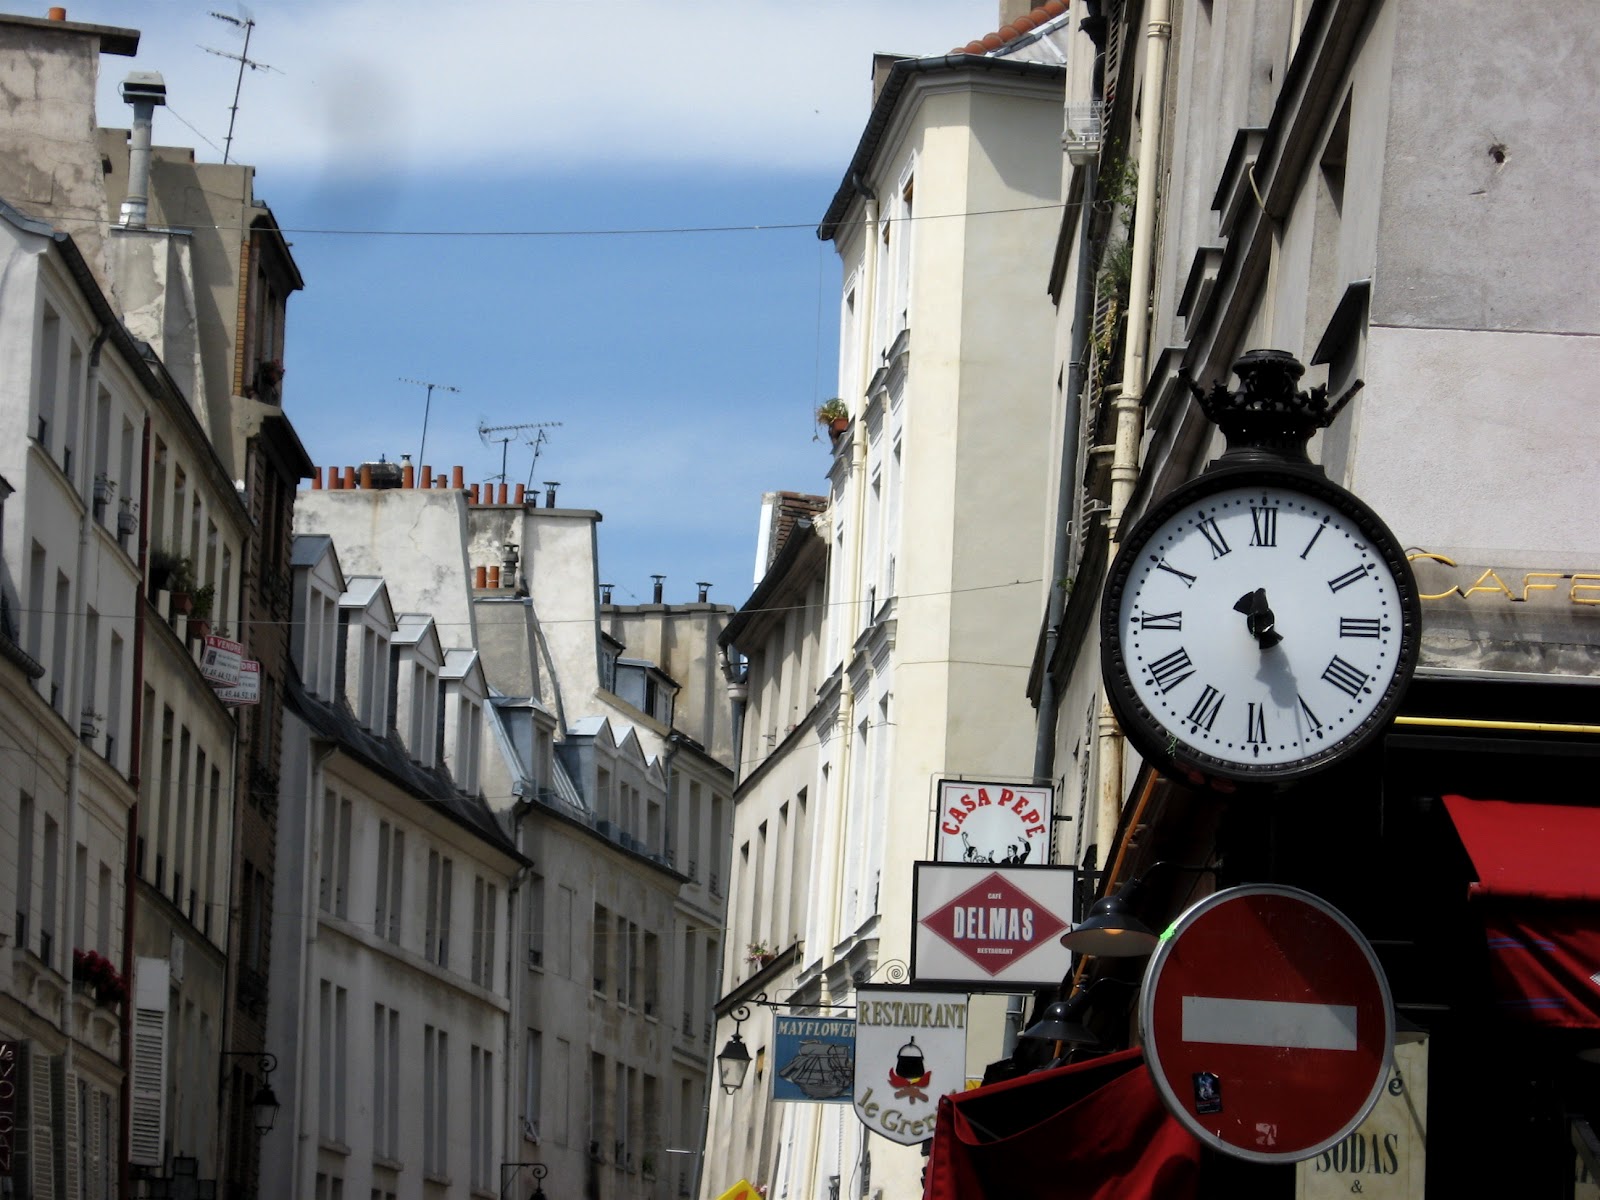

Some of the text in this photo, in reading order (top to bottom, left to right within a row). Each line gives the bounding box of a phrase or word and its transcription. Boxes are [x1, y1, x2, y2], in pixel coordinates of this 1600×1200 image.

[1196, 517, 1232, 560] XI
[1249, 507, 1278, 547] XII
[1300, 523, 1326, 560] I
[1156, 558, 1197, 588] X
[1327, 564, 1369, 593] II
[1141, 610, 1182, 631] IX
[1339, 617, 1381, 639] III
[217, 639, 241, 654] VENDRE
[941, 788, 1046, 839] CASA PEPE
[953, 906, 1034, 942] DELMAS
[976, 947, 1013, 955] RESTAURANT
[858, 1001, 966, 1029] RESTAURANT
[857, 1087, 879, 1118] le
[1351, 1180, 1363, 1194] &
